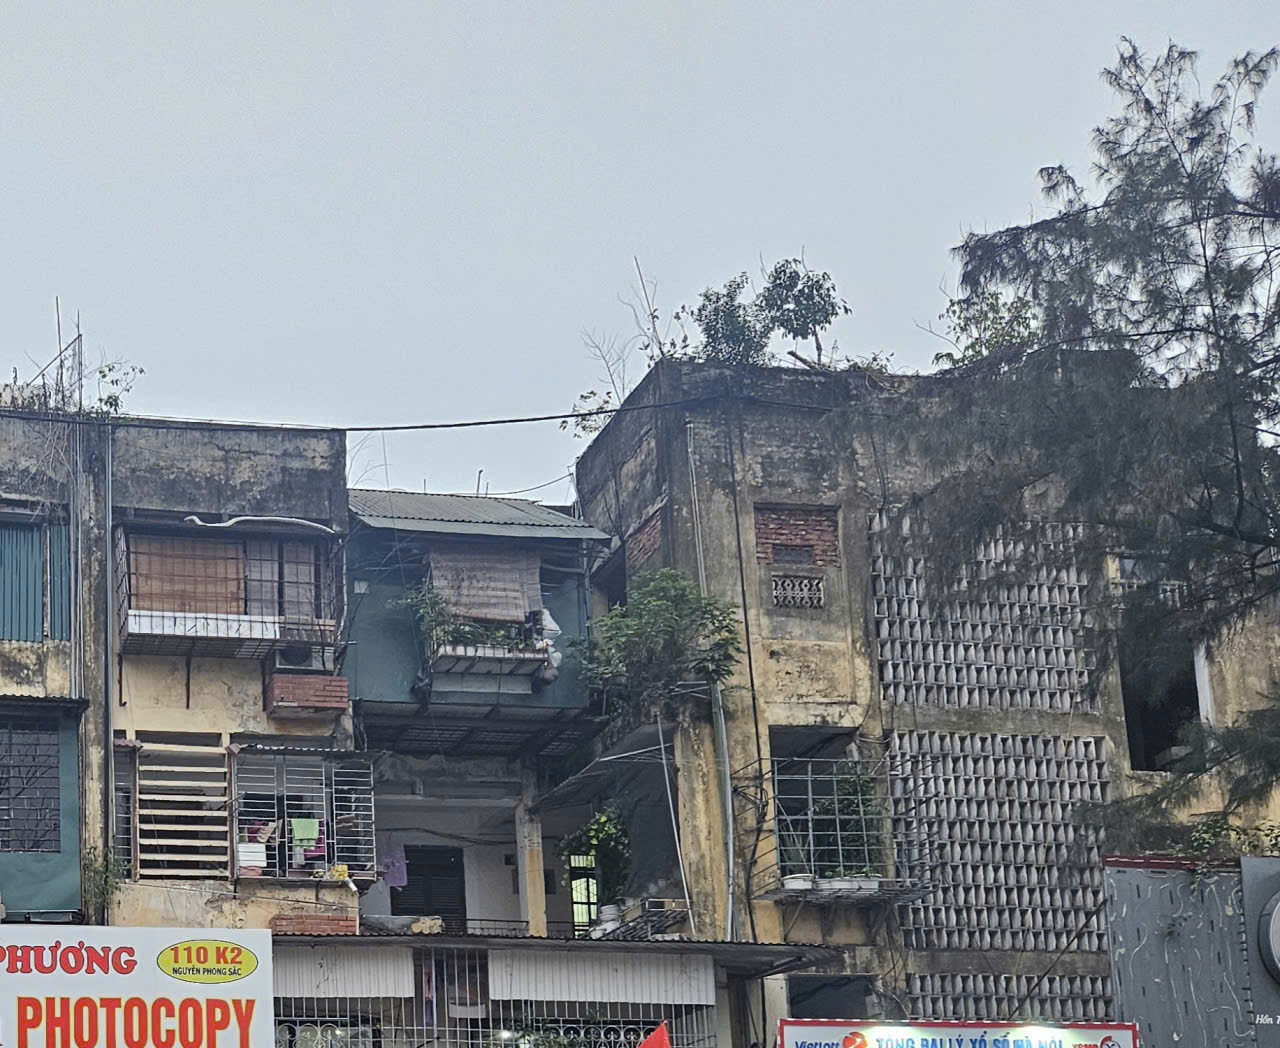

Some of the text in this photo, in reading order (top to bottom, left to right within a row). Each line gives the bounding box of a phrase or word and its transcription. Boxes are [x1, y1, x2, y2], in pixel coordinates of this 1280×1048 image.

[170, 946, 242, 965] 110 K2
[203, 967, 227, 976] PHONG
